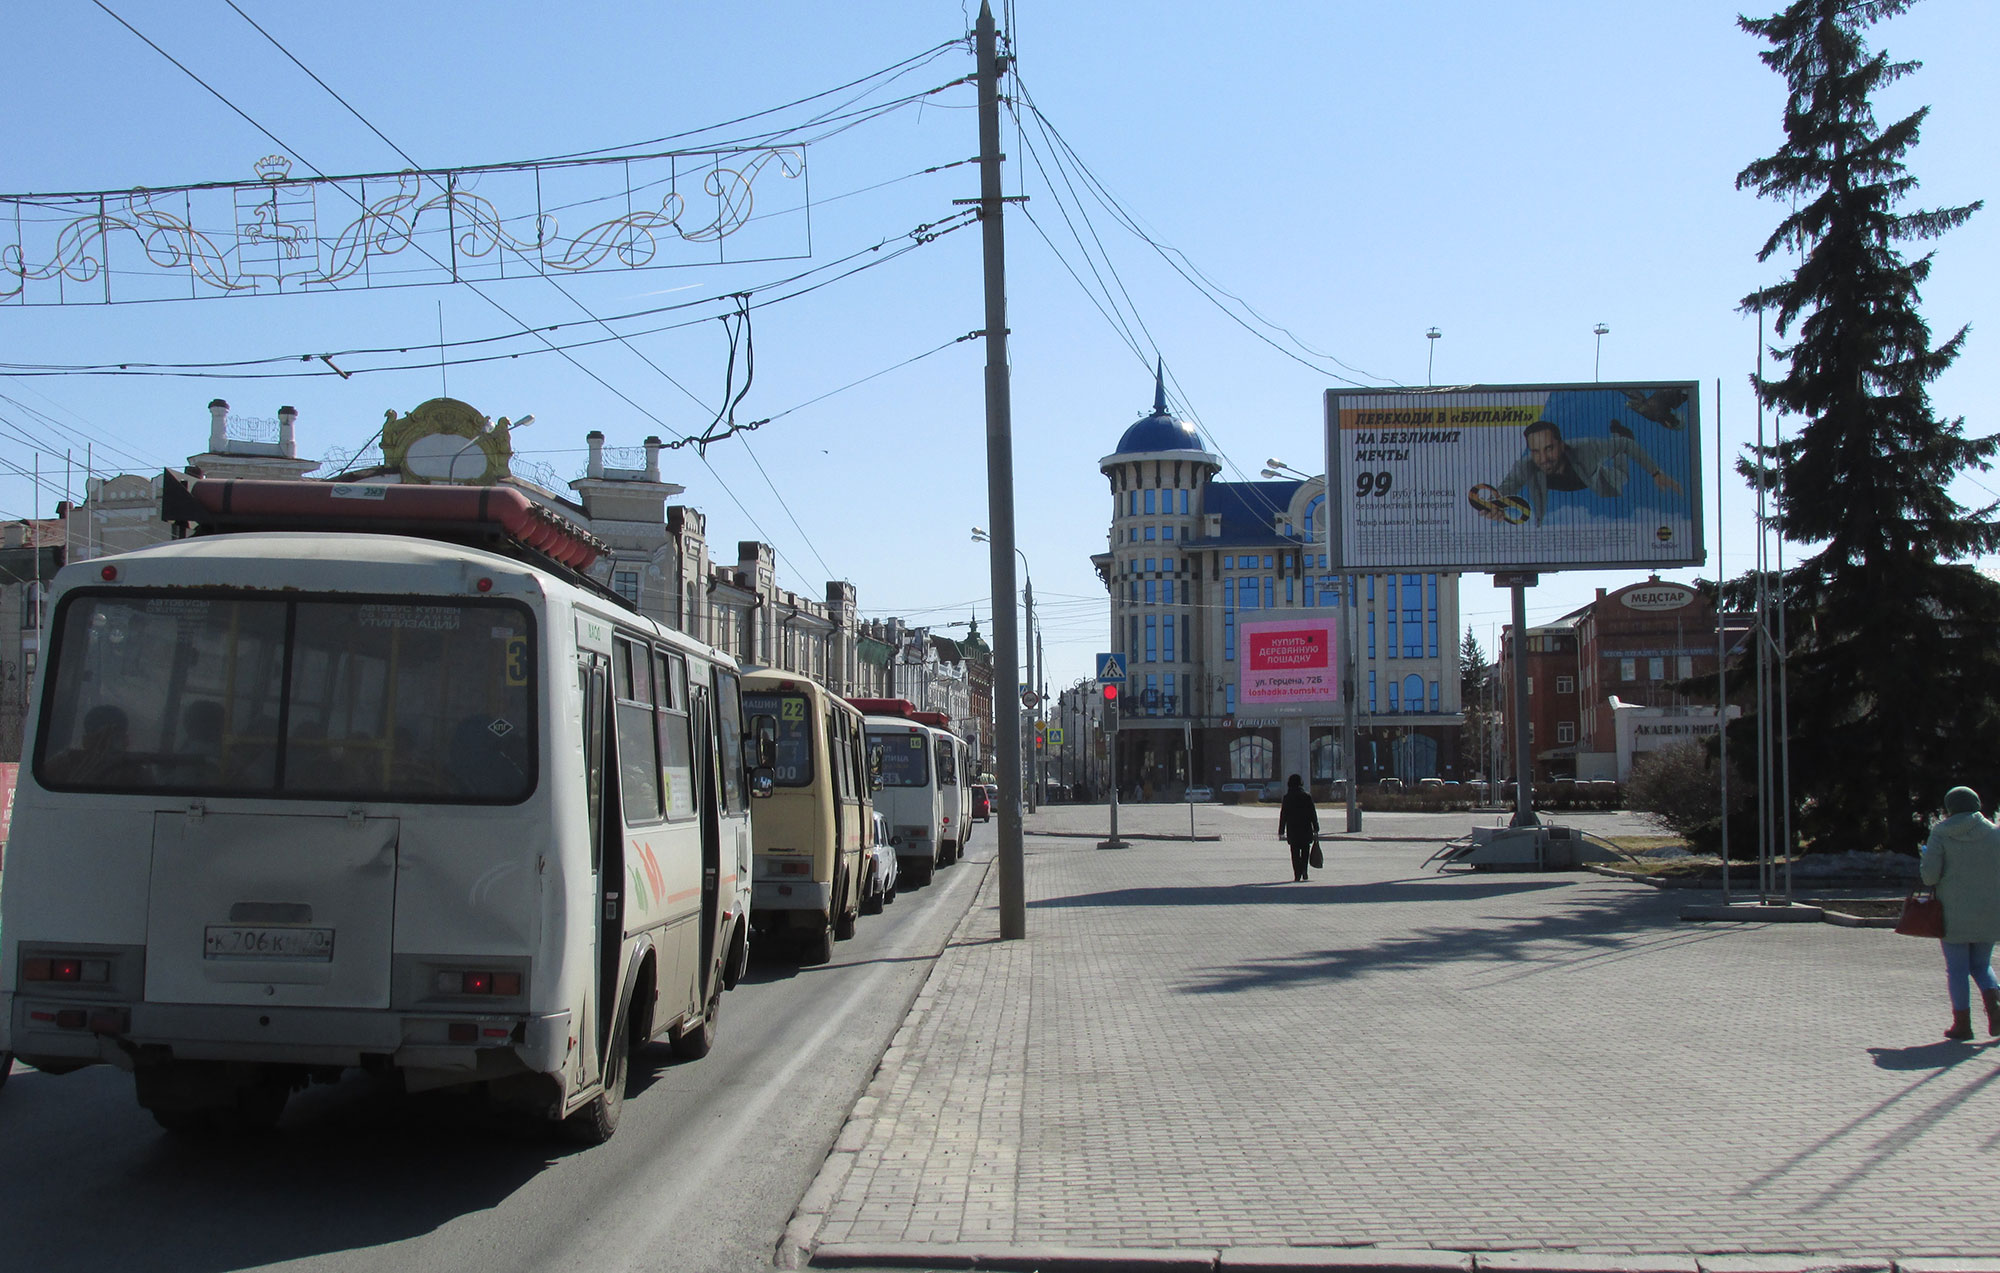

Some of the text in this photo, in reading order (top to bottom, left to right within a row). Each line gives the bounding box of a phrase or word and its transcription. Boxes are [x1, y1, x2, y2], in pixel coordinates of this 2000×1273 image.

[1355, 407, 1533, 426] ПЕРЕХОДИ В «БИЛАЙН»
[1355, 430, 1461, 445] НА БЕЗЛИМИТ
[1355, 449, 1410, 462] МЕЧТЫ
[1356, 471, 1393, 498] 99
[1631, 592, 1685, 604] МЕДСТАР
[1271, 637, 1306, 647] КУПИТЬ
[1258, 645, 1319, 657] ДЕРЕВЯННУЮ
[509, 640, 527, 681] 3
[1267, 654, 1312, 665] ЛОШАДКУ
[1255, 680, 1267, 688] ул.
[1269, 676, 1304, 688] Герцена,
[1248, 687, 1329, 697] loshadka.tomsk.ru
[784, 701, 803, 718] 22
